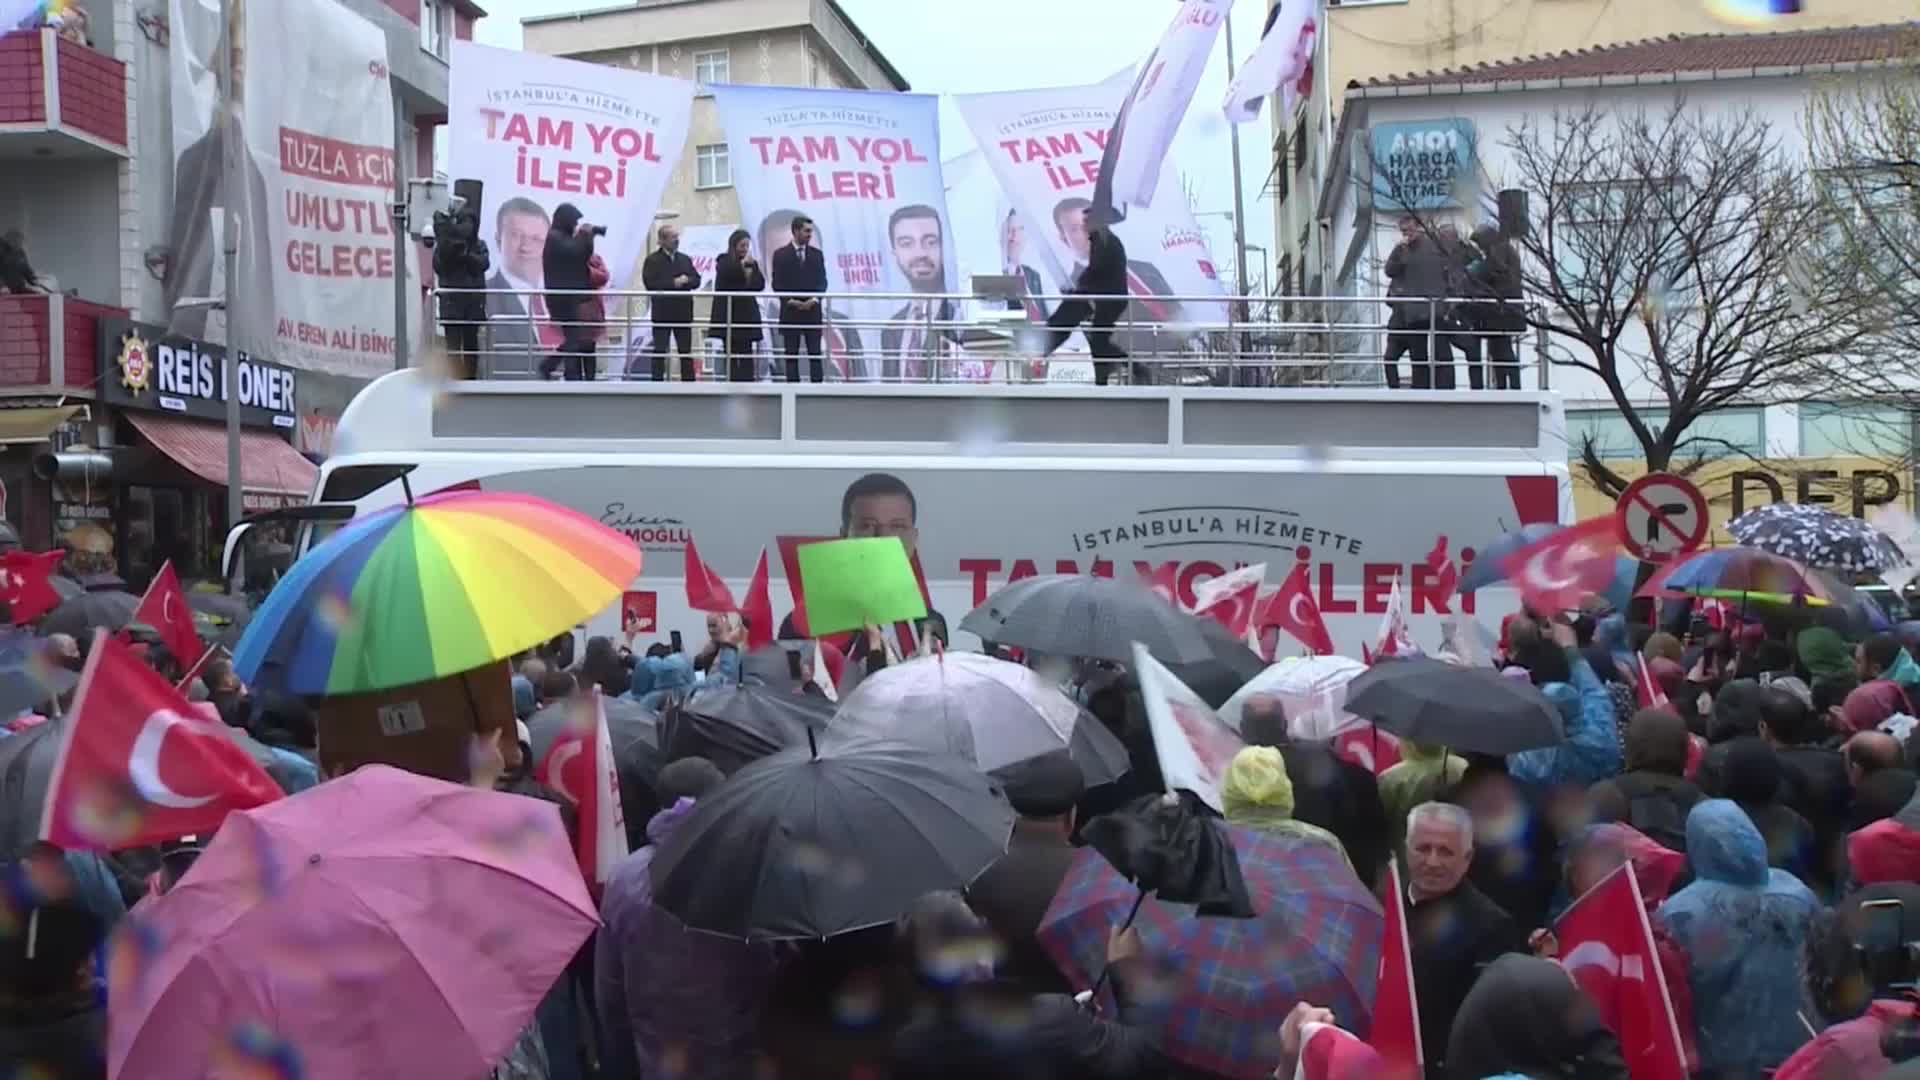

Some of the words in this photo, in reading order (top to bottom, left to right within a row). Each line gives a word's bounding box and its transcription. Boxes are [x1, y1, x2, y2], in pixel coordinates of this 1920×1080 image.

[480, 108, 573, 151] TAM
[585, 122, 661, 163] YOL
[749, 135, 840, 165] TAM
[846, 137, 928, 164] YOL
[999, 132, 1082, 164] TAM
[1084, 128, 1113, 151] Y
[283, 137, 349, 177] TUZLA
[516, 145, 627, 198] İLERİ
[1043, 160, 1100, 190] İLE
[1389, 151, 1456, 168] HARCA
[792, 165, 895, 201] İLERİ
[286, 240, 393, 278] GELECE
[332, 325, 356, 351] ALİ
[158, 342, 214, 399] REİS
[616, 526, 691, 543] MOĞLU
[1073, 517, 1224, 552] İSTANBUL'A
[1236, 515, 1363, 556] HİZMETTE
